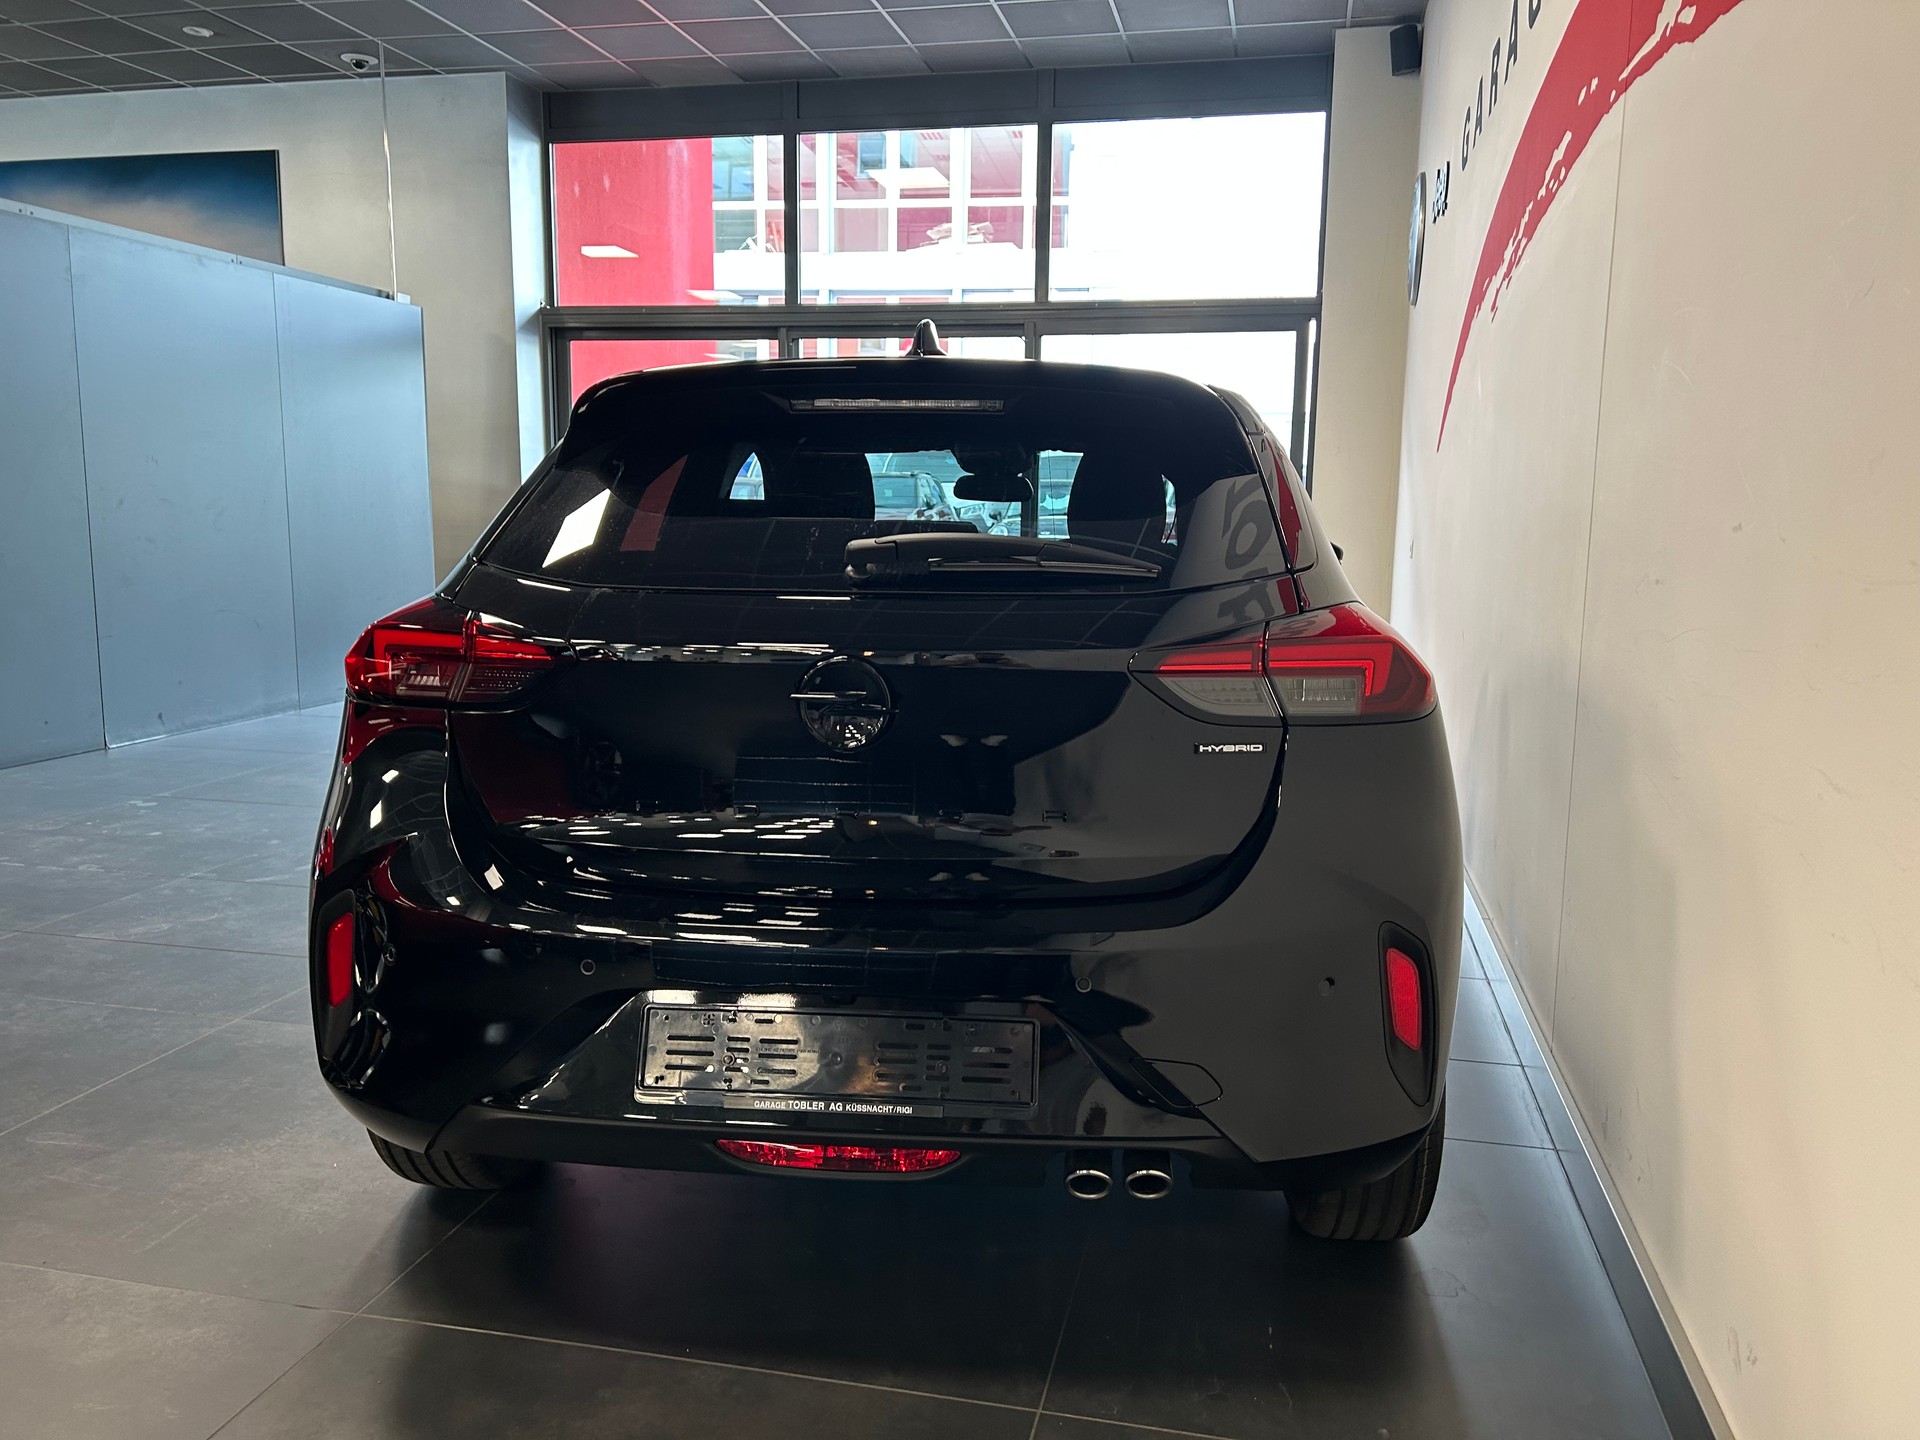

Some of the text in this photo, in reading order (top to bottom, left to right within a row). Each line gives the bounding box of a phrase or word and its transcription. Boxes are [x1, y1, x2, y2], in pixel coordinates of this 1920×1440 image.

[1199, 744, 1263, 752] HYBRID
[754, 1100, 913, 1114] GARAGE TOBLER AG KÜSSNACHT/RIGI
